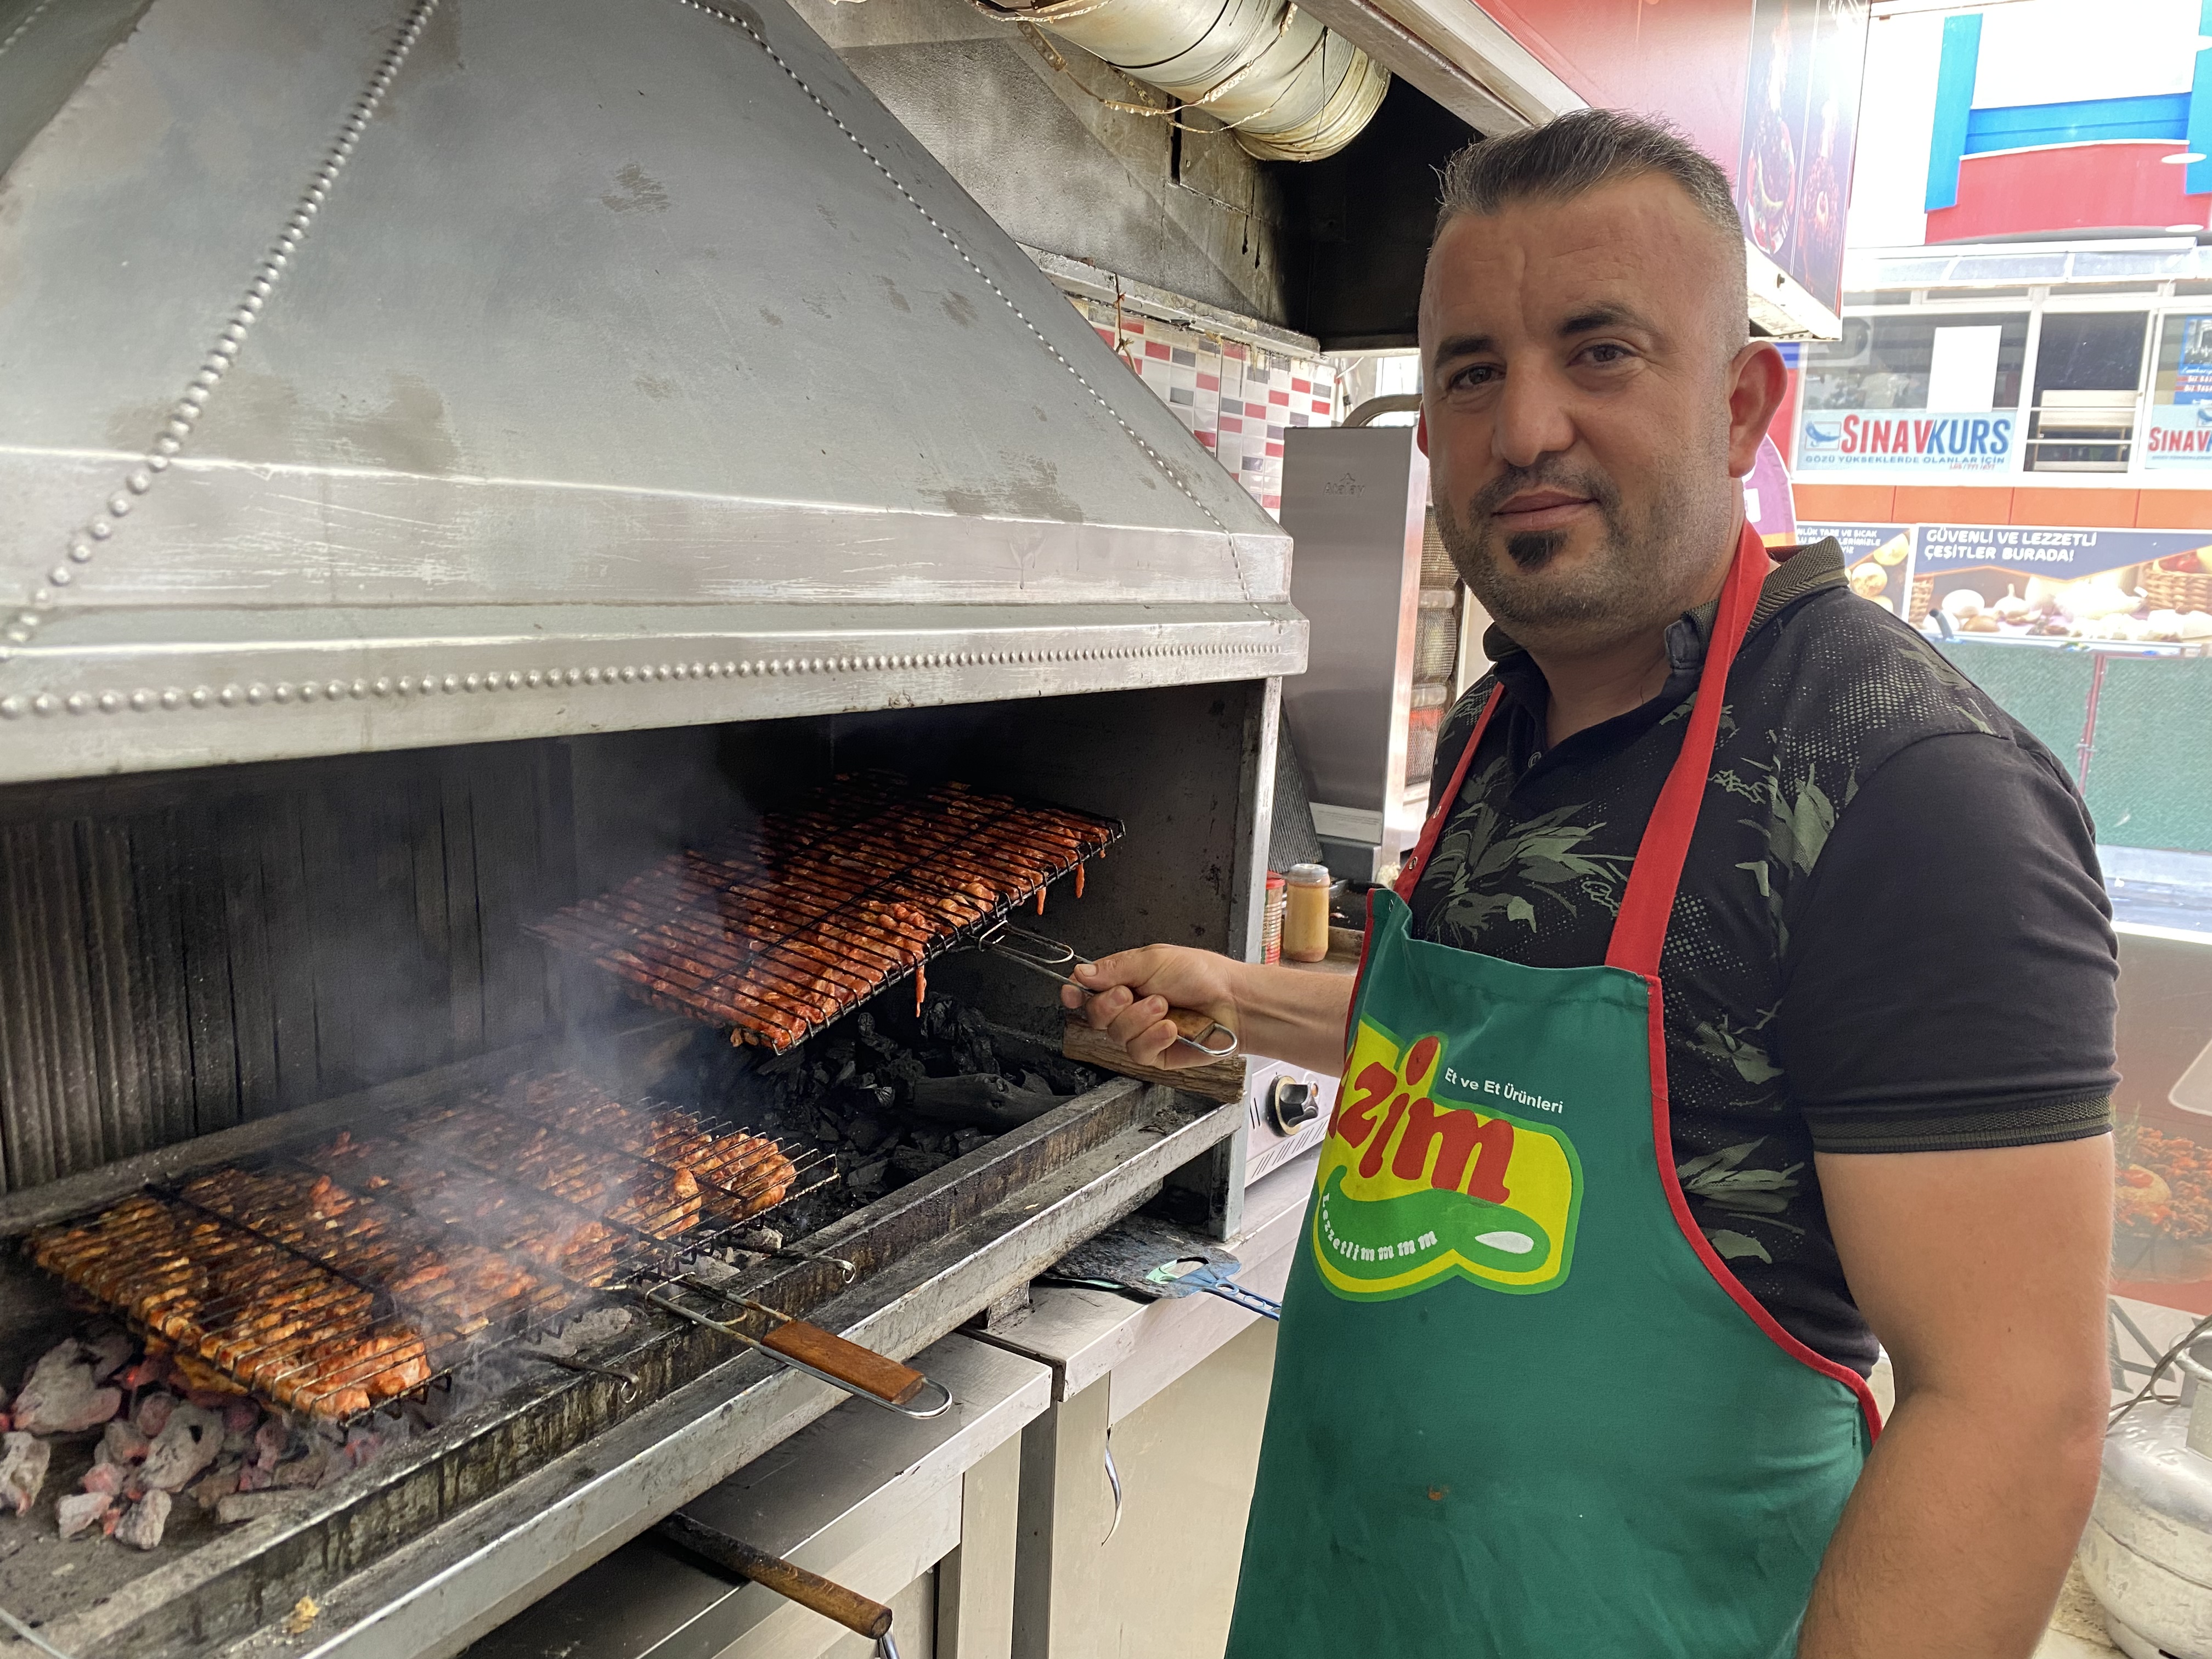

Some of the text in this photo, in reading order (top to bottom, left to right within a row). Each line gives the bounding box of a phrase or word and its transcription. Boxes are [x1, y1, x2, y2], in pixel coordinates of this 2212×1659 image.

[1841, 413, 2011, 455] SINAVKURS
[1838, 455, 1920, 464] YÜKSEKLERDE
[1923, 456, 1977, 464] OLANLAR
[1981, 455, 2005, 465] İÇİN
[1797, 527, 1818, 536] NLÜK
[1926, 527, 2097, 547] GÜVENLİ VE LEZZETLİ
[1924, 544, 2075, 562] ÇEŞİTLER BURADA!
[1444, 1067, 1564, 1114] Et ve Et Ürünleri
